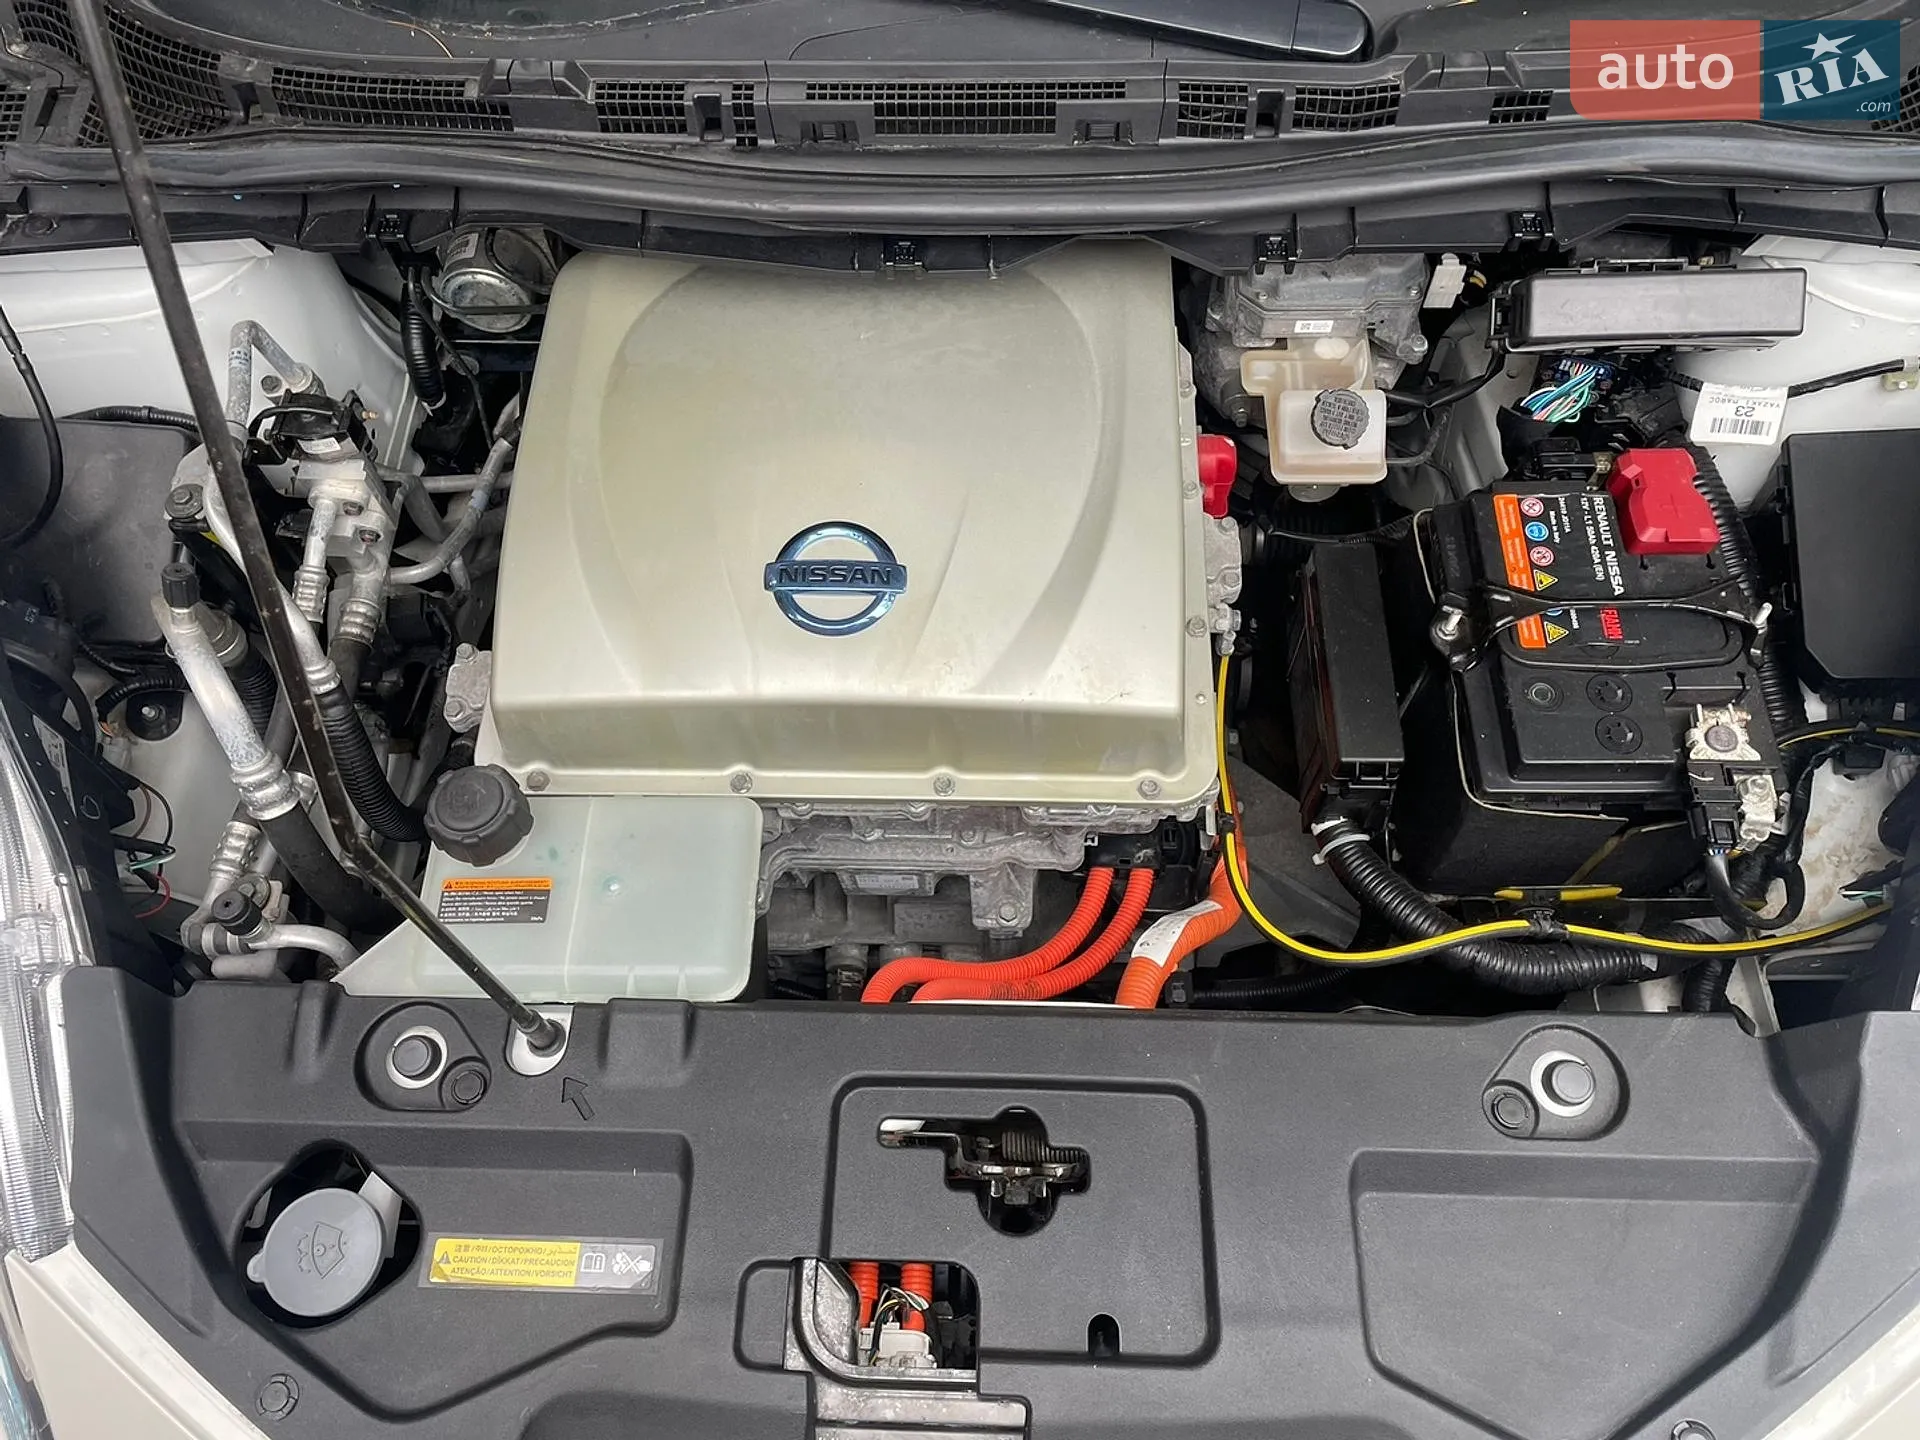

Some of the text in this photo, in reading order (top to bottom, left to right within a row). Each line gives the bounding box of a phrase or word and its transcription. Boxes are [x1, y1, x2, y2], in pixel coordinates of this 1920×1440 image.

[1734, 405, 1756, 418] 23
[1593, 497, 1625, 596] RENAULT NISSA
[779, 563, 893, 586] NISSAN
